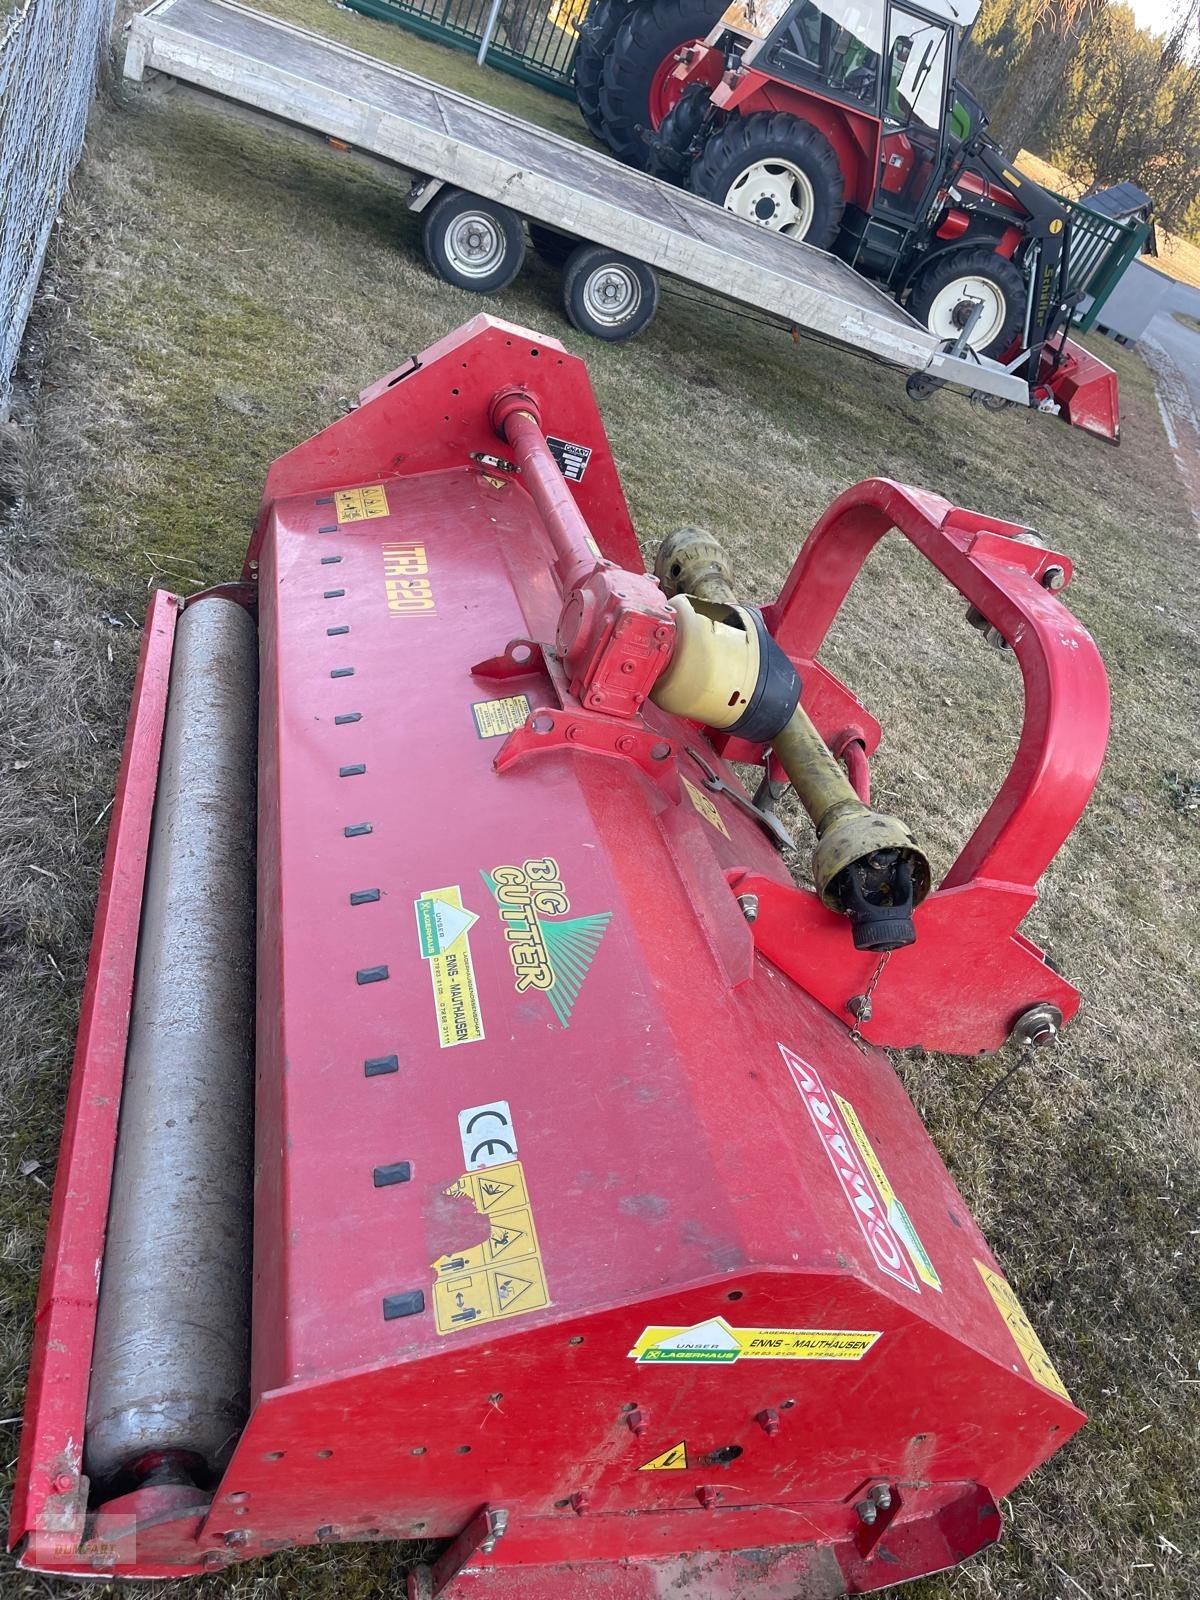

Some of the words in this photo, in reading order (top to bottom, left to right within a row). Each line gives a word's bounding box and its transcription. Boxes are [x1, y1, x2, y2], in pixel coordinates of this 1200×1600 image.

[382, 547, 429, 576] TFR
[385, 579, 435, 610] 220
[524, 859, 568, 915] BIG
[423, 909, 435, 954] LAGERHAUS
[436, 912, 445, 938] UNSER
[493, 867, 553, 991] CUTTER
[446, 954, 459, 977] ENNS
[450, 983, 468, 1041] MAUTHAUSEN
[791, 1059, 901, 1271] OMARV
[749, 1339, 783, 1348] ENNS
[792, 1340, 870, 1350] MAUTHAUSEN
